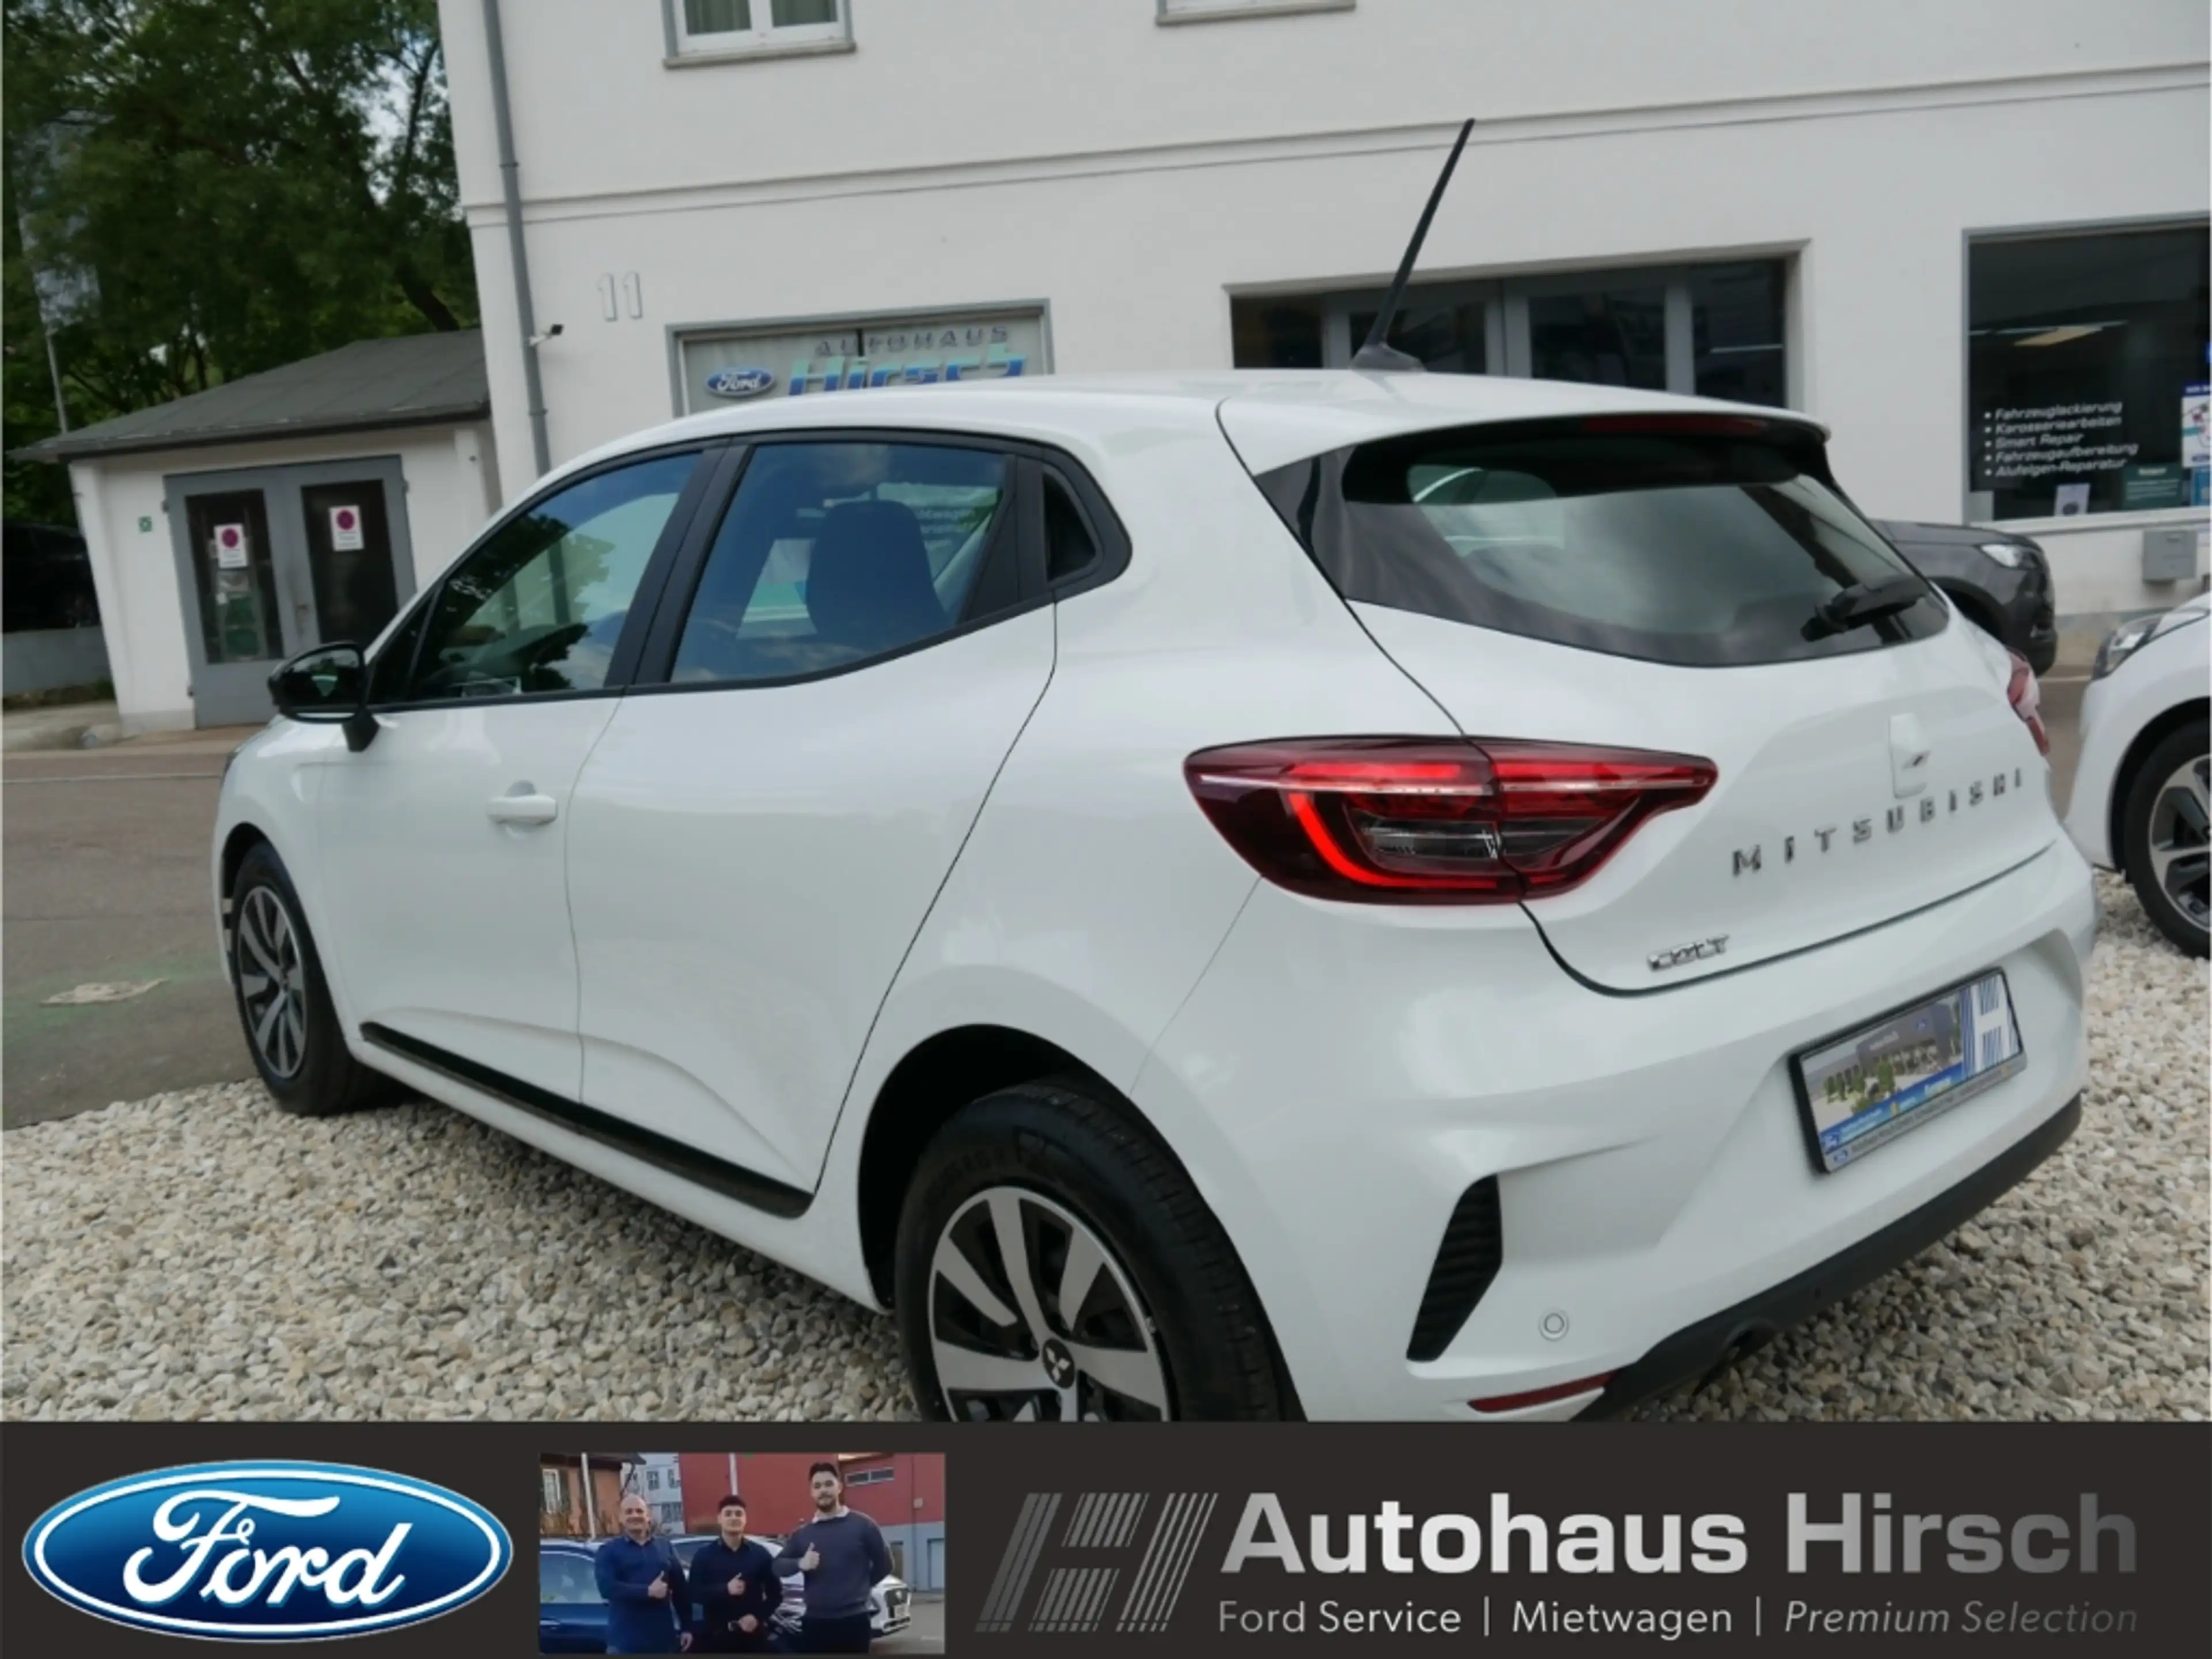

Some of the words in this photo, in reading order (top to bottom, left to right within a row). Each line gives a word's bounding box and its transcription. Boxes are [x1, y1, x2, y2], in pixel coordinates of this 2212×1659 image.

[596, 269, 643, 323] 11
[814, 325, 1008, 357] AUTOHAUS
[717, 371, 762, 391] Ford
[1994, 402, 2123, 421] Fahrzeuglackierung
[1995, 416, 2122, 434] Karosseriearbeiten
[1995, 436, 2036, 449] Smart
[2040, 433, 2085, 446] Repair
[1995, 443, 2139, 463] Fahrzeugaufbereitung
[1731, 767, 2022, 877] MITSUBISHI
[1646, 934, 1730, 973] COLT
